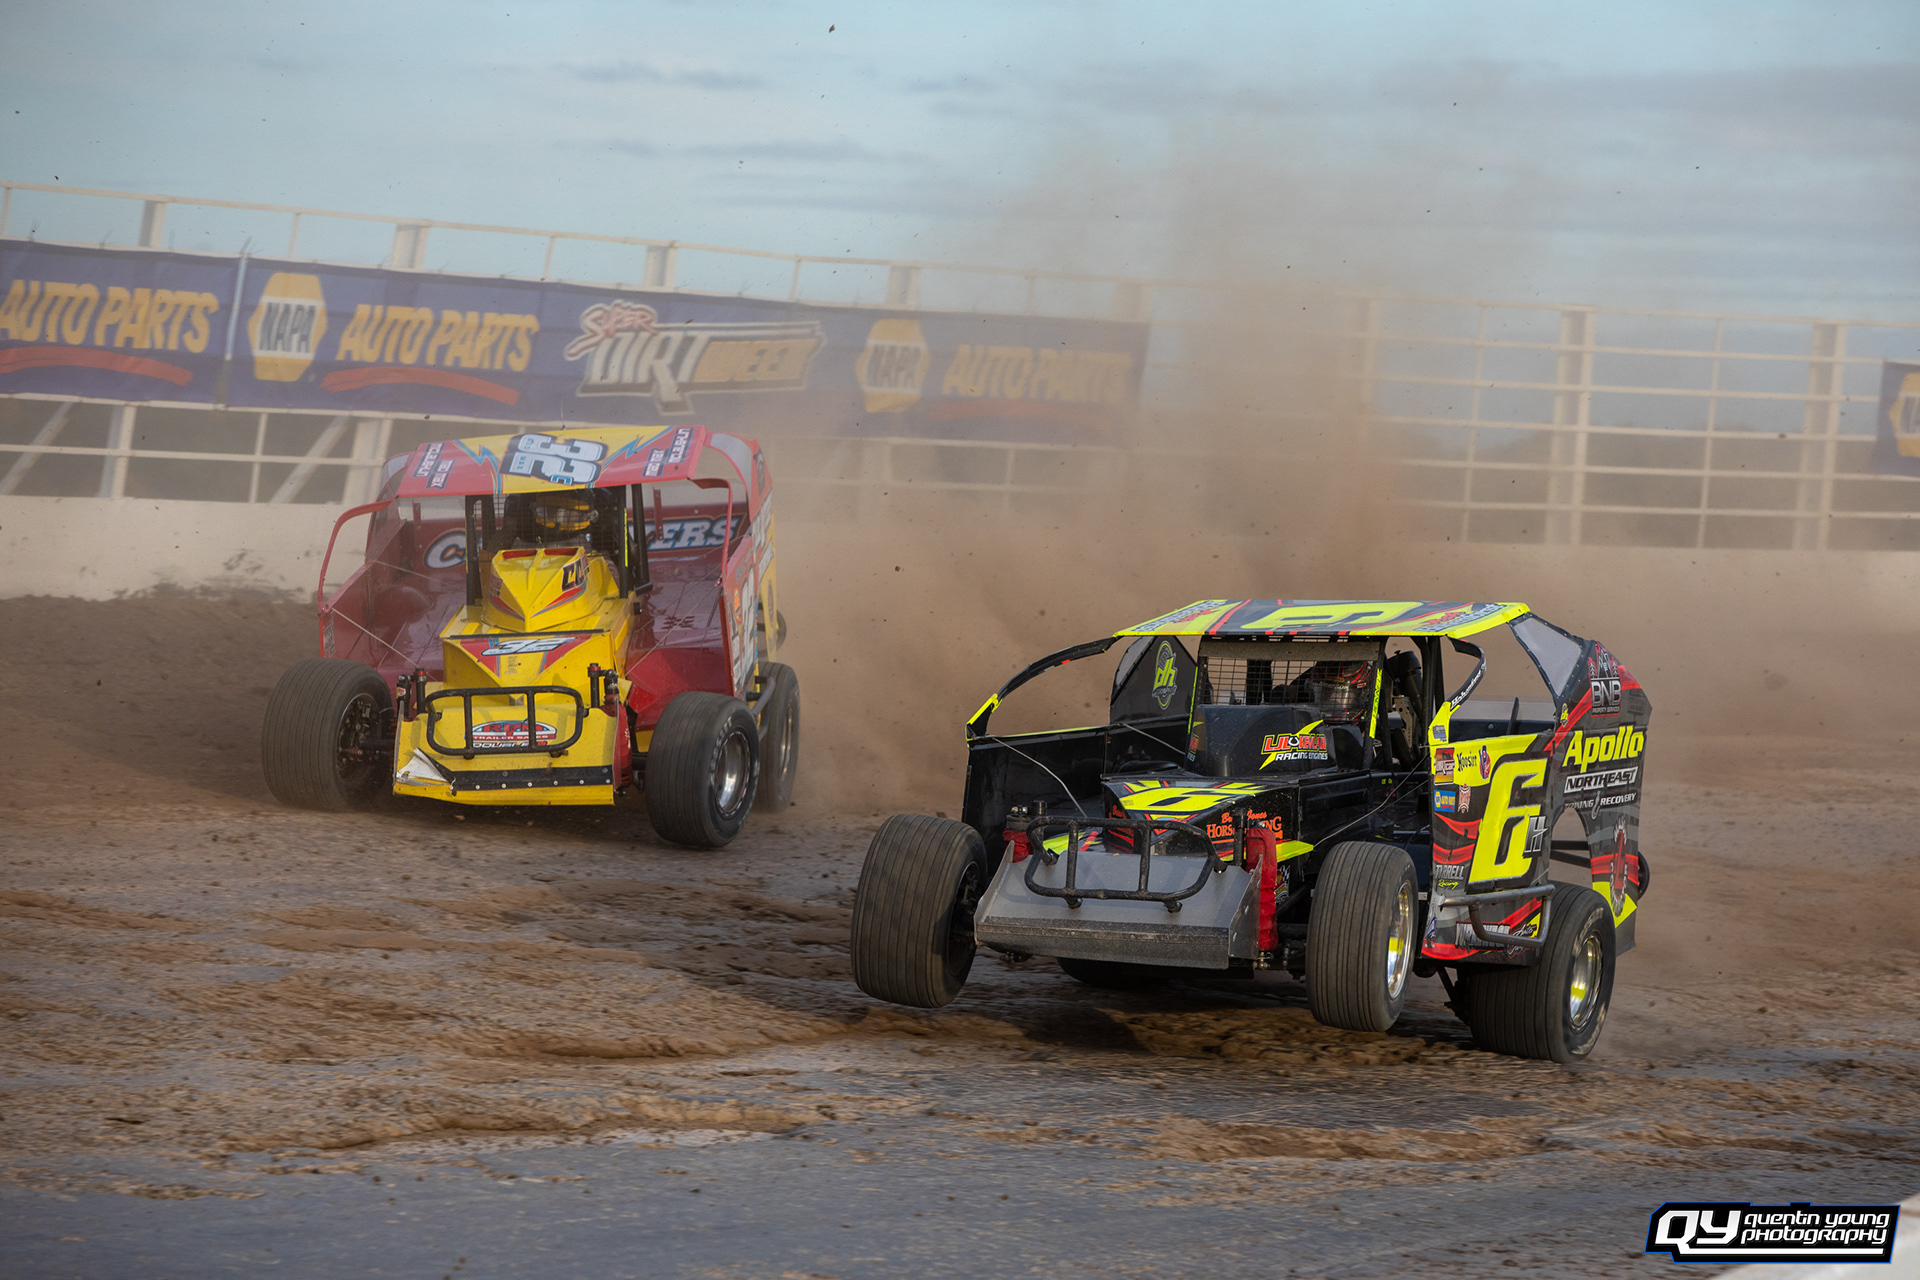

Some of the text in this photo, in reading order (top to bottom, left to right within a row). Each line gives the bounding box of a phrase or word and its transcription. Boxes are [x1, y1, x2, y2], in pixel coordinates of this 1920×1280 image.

[0, 279, 219, 353] AUTO PARTS
[259, 301, 317, 353] NAPA
[335, 303, 540, 372] AUTO PARTS
[588, 329, 710, 401] DIRT
[942, 344, 1034, 399] AUTO
[509, 434, 603, 483] 32
[1591, 681, 1621, 707] BNB
[1275, 752, 1328, 761] RACING ENGINES
[1298, 735, 1326, 750] KEVLAR
[1562, 725, 1644, 773] Apollo
[1457, 752, 1477, 772] Hoosier
[1566, 769, 1636, 790] NORTHEAST
[1600, 793, 1637, 806] RECOVERY
[1469, 759, 1548, 884] 6
[1435, 864, 1465, 880] TYRRELL
[1438, 879, 1459, 890] Racing
